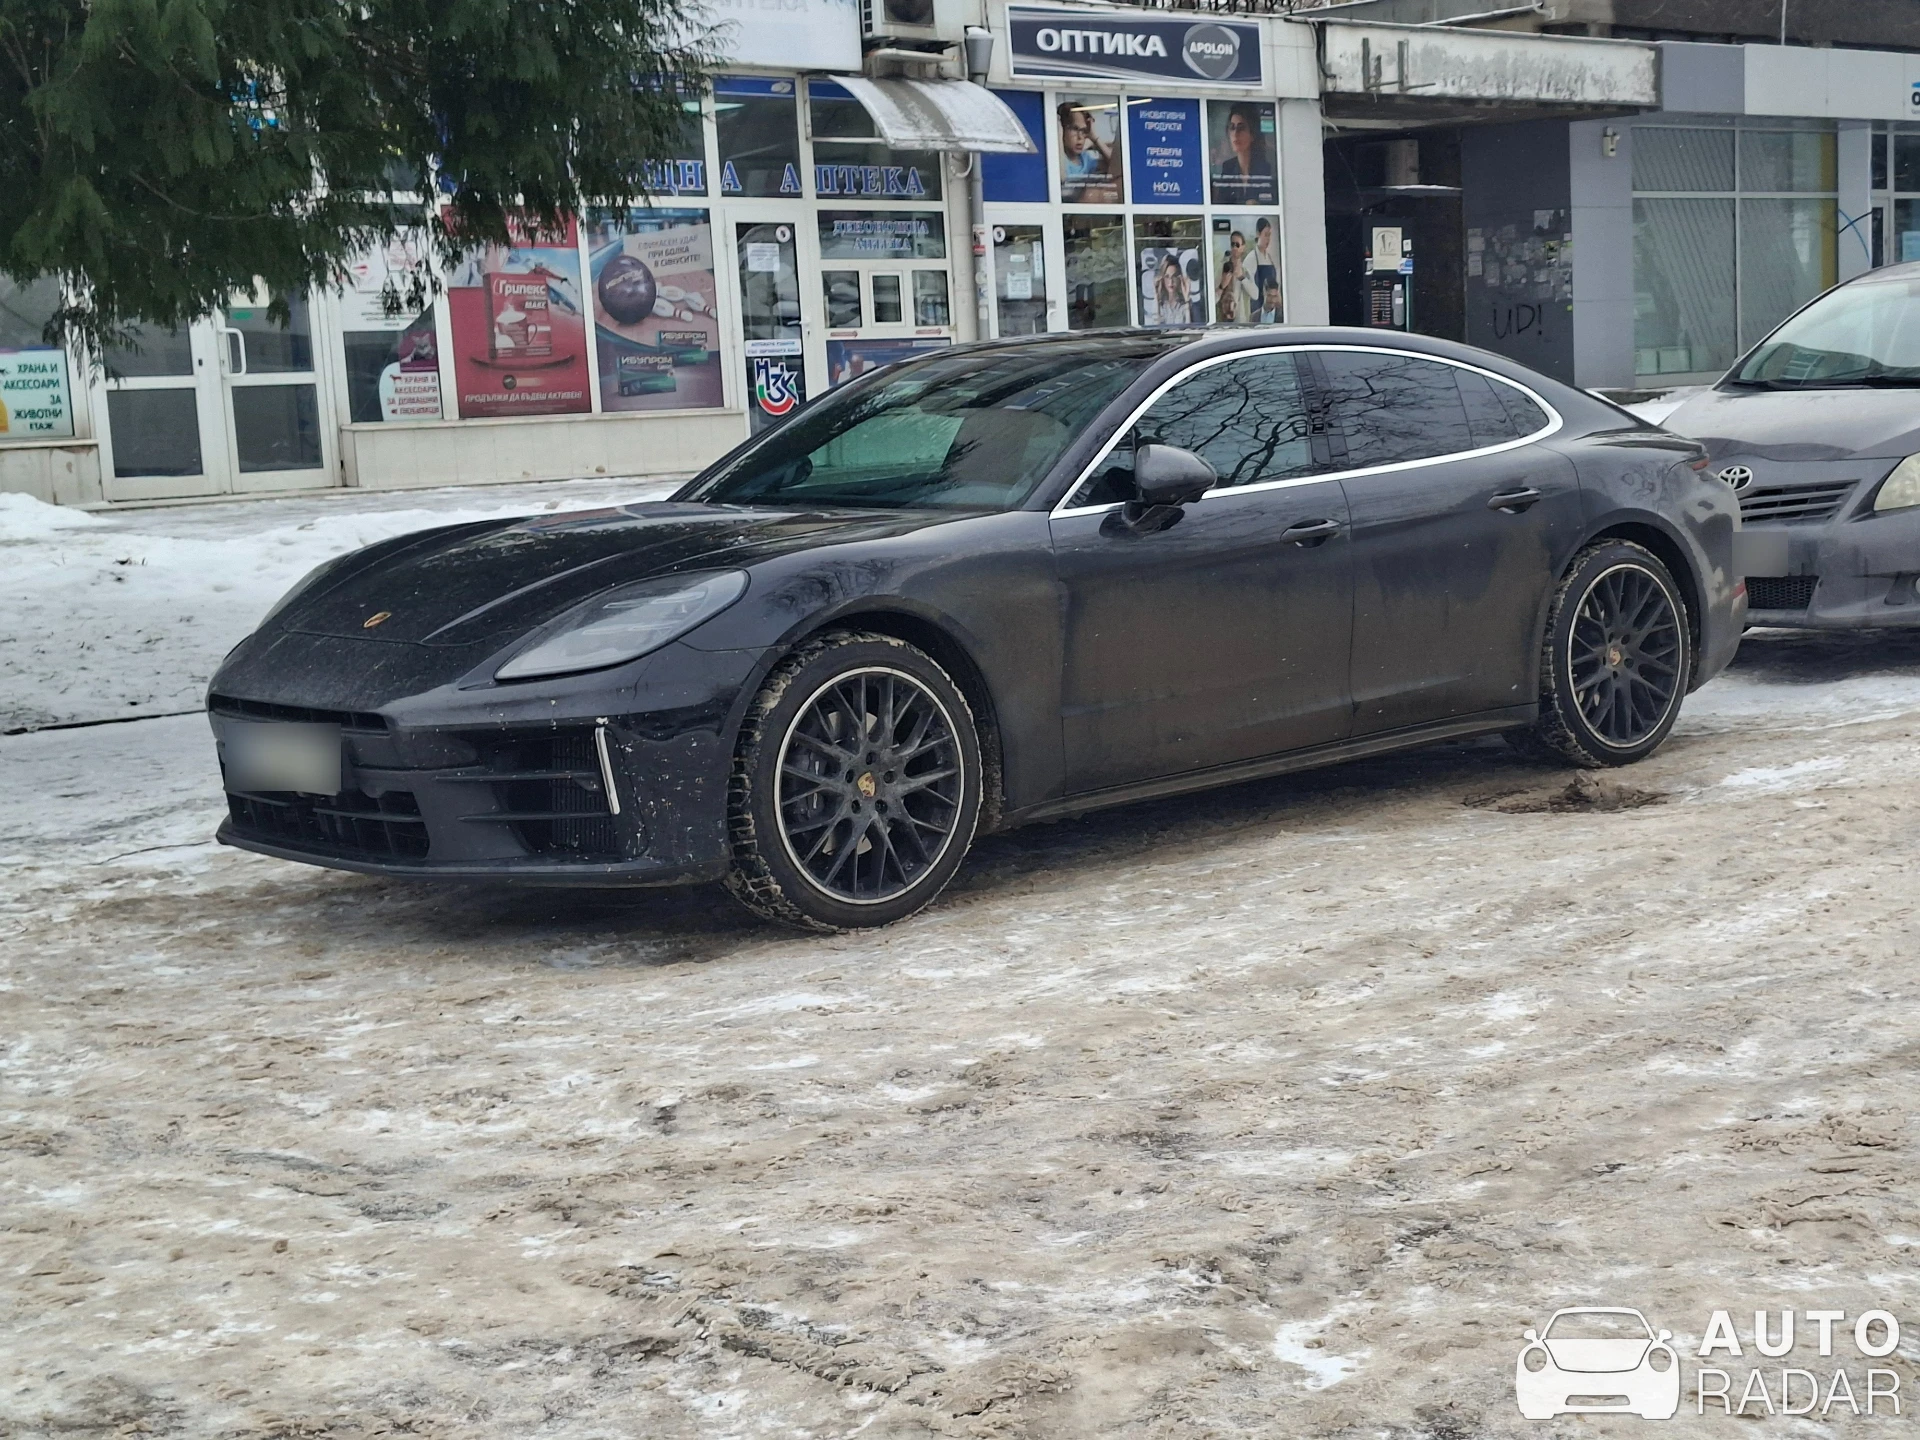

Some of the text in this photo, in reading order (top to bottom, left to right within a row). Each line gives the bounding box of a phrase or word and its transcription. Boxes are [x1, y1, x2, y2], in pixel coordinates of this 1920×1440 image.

[1036, 28, 1167, 57] ОПТИКА
[1190, 41, 1233, 55] APOLON
[1145, 158, 1184, 167] КАЧЕСТВО
[780, 162, 925, 196] АПТЕКА
[1153, 181, 1180, 192] HOYA
[648, 246, 690, 259] ПРИ БОЛКА
[500, 280, 547, 297] Грипекс
[1493, 303, 1543, 339] UD!
[621, 356, 673, 366] ИБУПРОМ
[17, 363, 58, 373] ХРАНА И
[4, 379, 60, 390] АКСЕСОАРИ
[49, 394, 62, 405] ЗА
[509, 393, 519, 402] ДА
[520, 392, 547, 401] БЪДЕШ
[14, 408, 62, 419] ЖИВОТНИ
